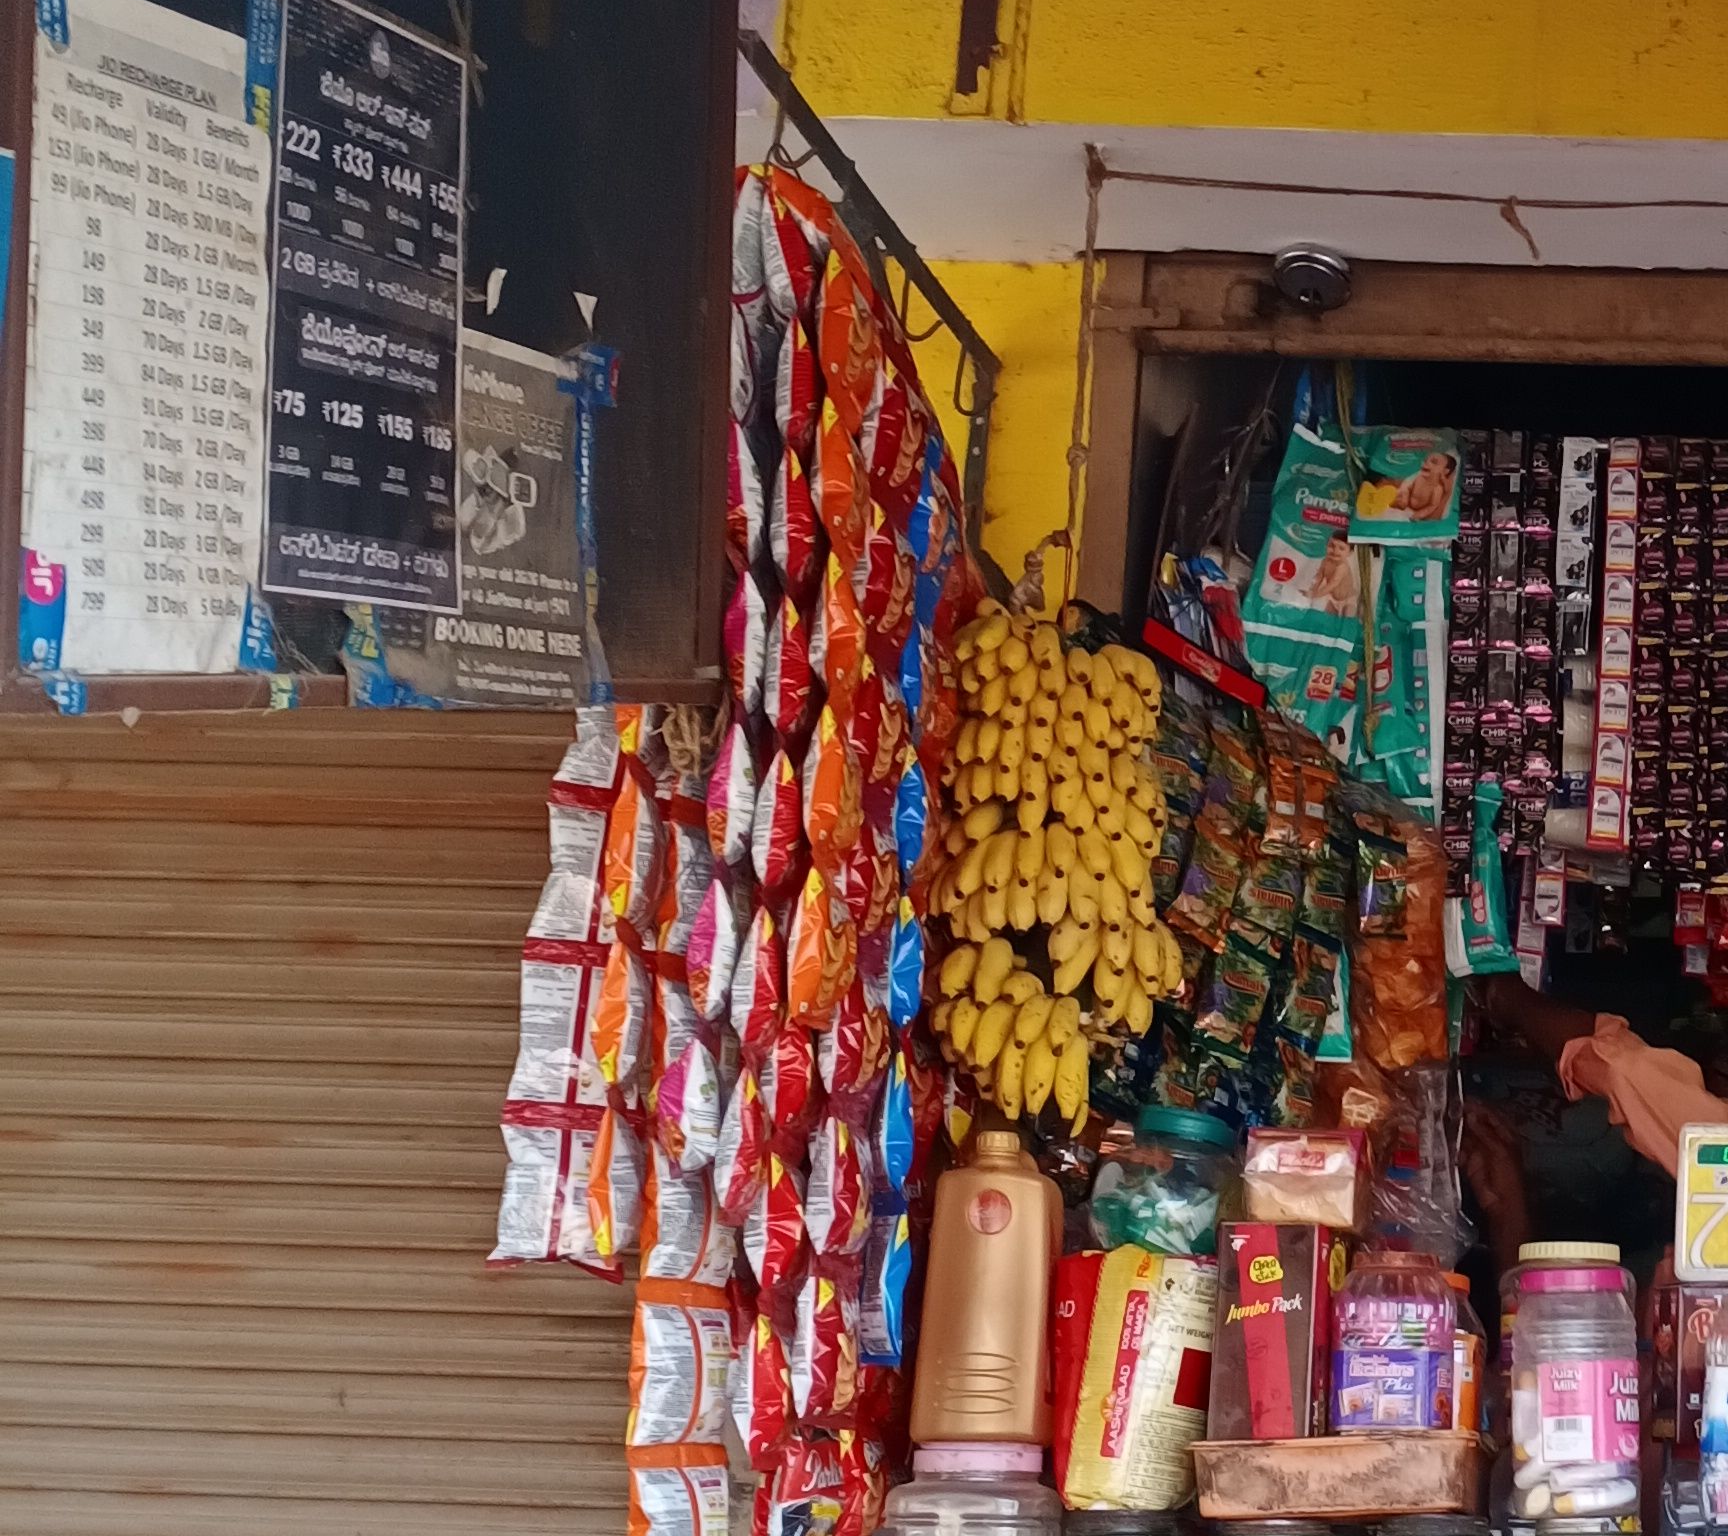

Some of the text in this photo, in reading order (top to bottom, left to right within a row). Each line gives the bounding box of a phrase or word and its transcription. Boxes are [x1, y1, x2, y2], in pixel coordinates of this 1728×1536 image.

[1464, 478, 1484, 487] HIK
[1295, 488, 1349, 512] Pampe
[1278, 557, 1288, 573] L
[1453, 594, 1480, 604] CHIK
[434, 616, 582, 657] BOOKING DONE HERE
[1450, 655, 1478, 664] CHIK
[1311, 670, 1333, 685] 28
[1448, 716, 1476, 726] CHIK
[1480, 728, 1508, 738] CHIK
[1446, 778, 1473, 788] CHIK
[1518, 802, 1547, 812] CHIK
[1443, 840, 1470, 849] CHIK
[1225, 1293, 1303, 1325] Jumbo Pack
[1552, 1380, 1579, 1392] Milk
[1609, 1371, 1638, 1396] Juiz
[802, 1449, 843, 1491] Parl
